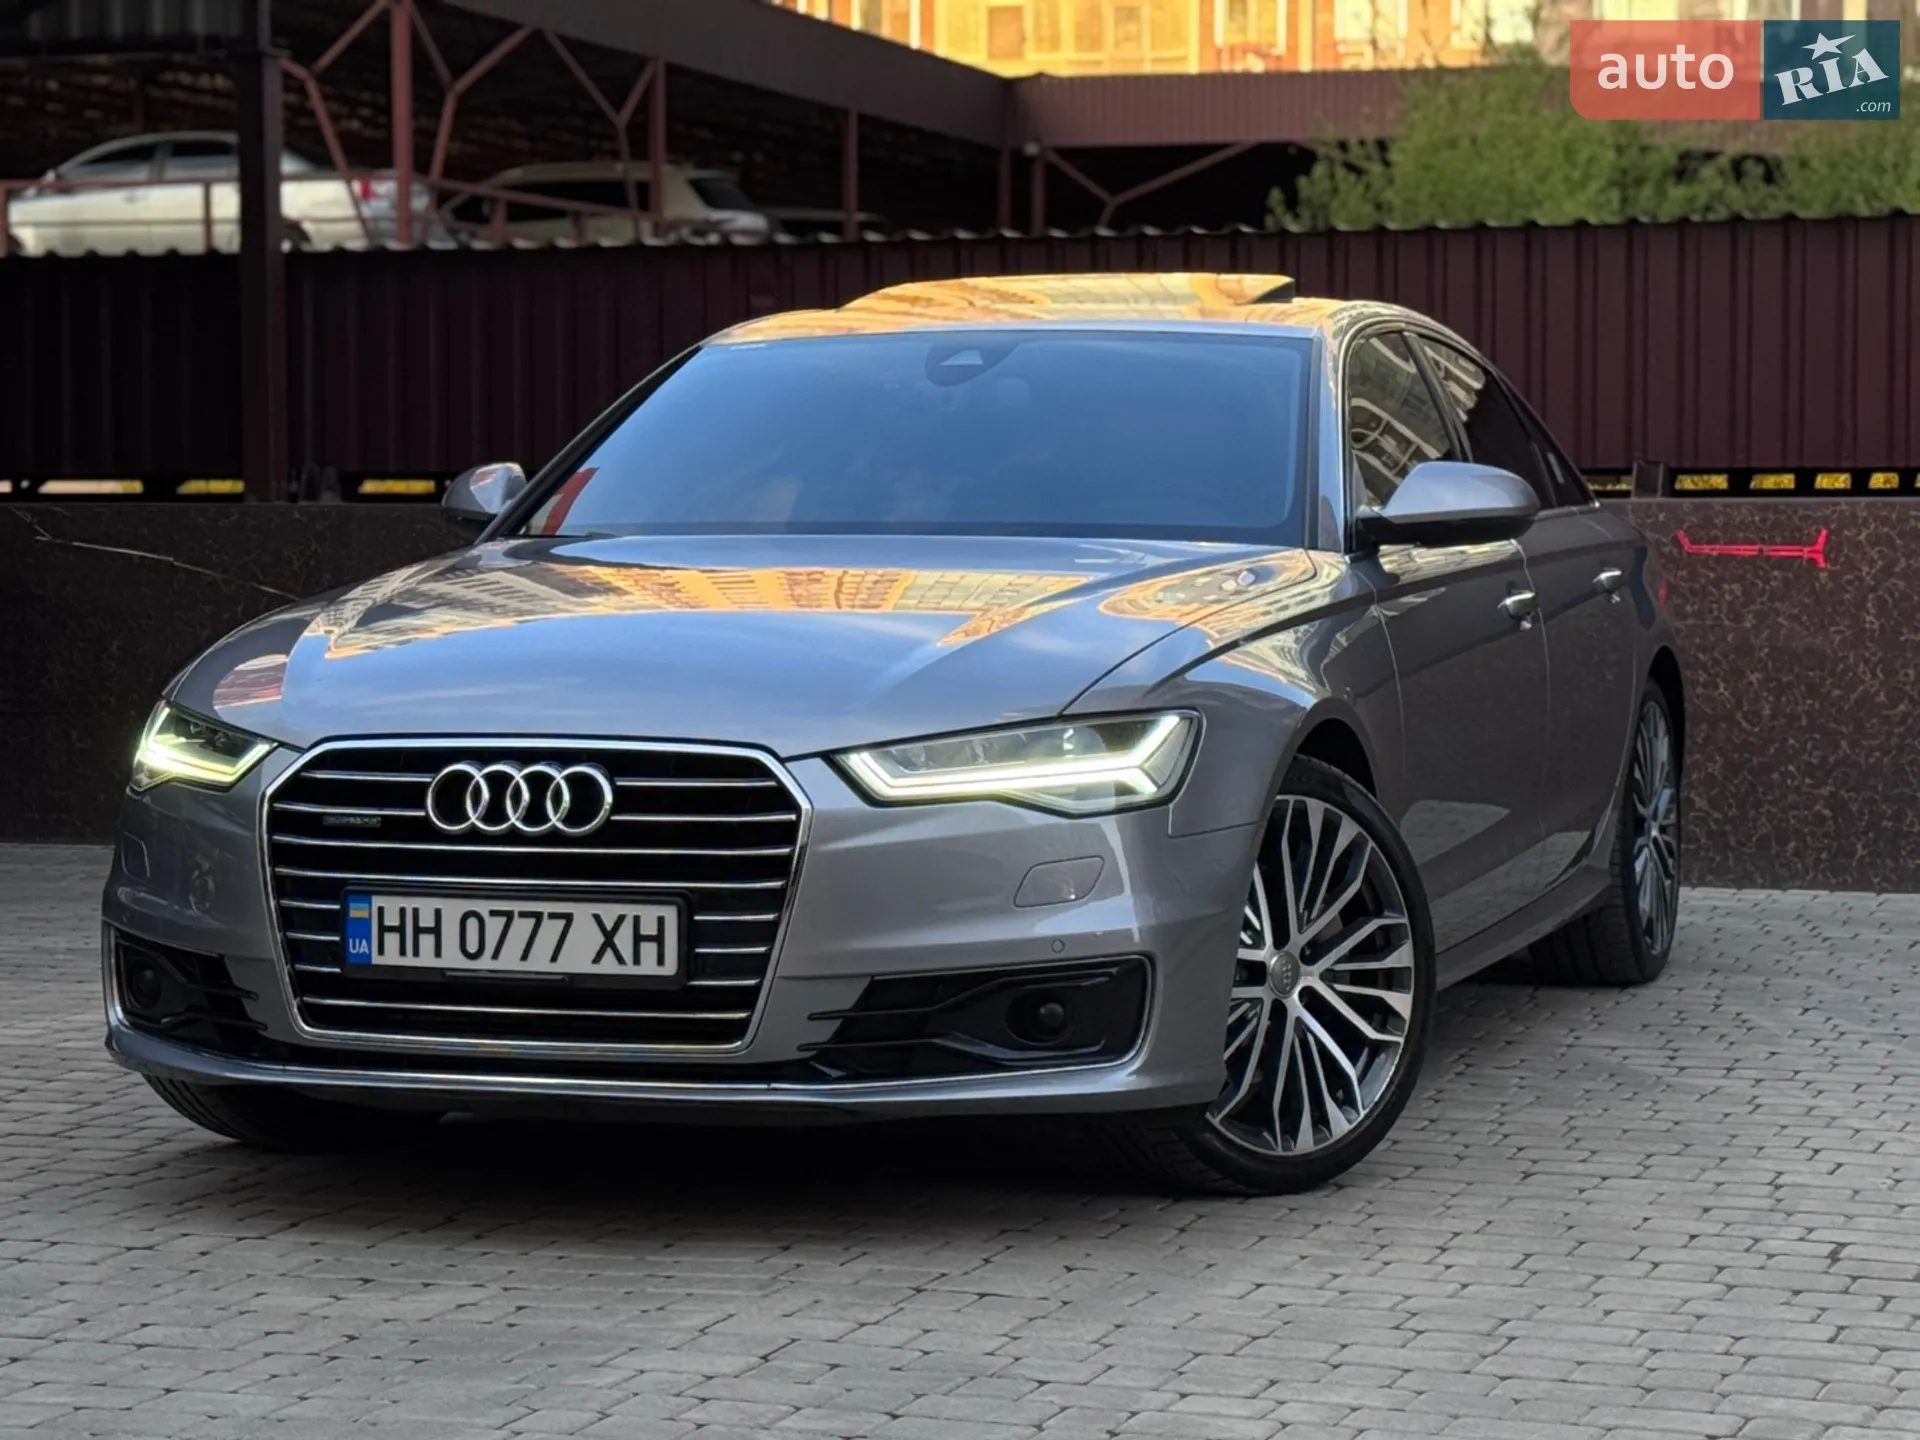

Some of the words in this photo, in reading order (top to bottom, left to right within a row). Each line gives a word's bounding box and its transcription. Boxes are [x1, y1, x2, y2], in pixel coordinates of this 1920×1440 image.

[349, 938, 369, 954] UA
[377, 906, 442, 958] HH
[459, 909, 574, 963] 0777
[591, 913, 666, 967] XH
